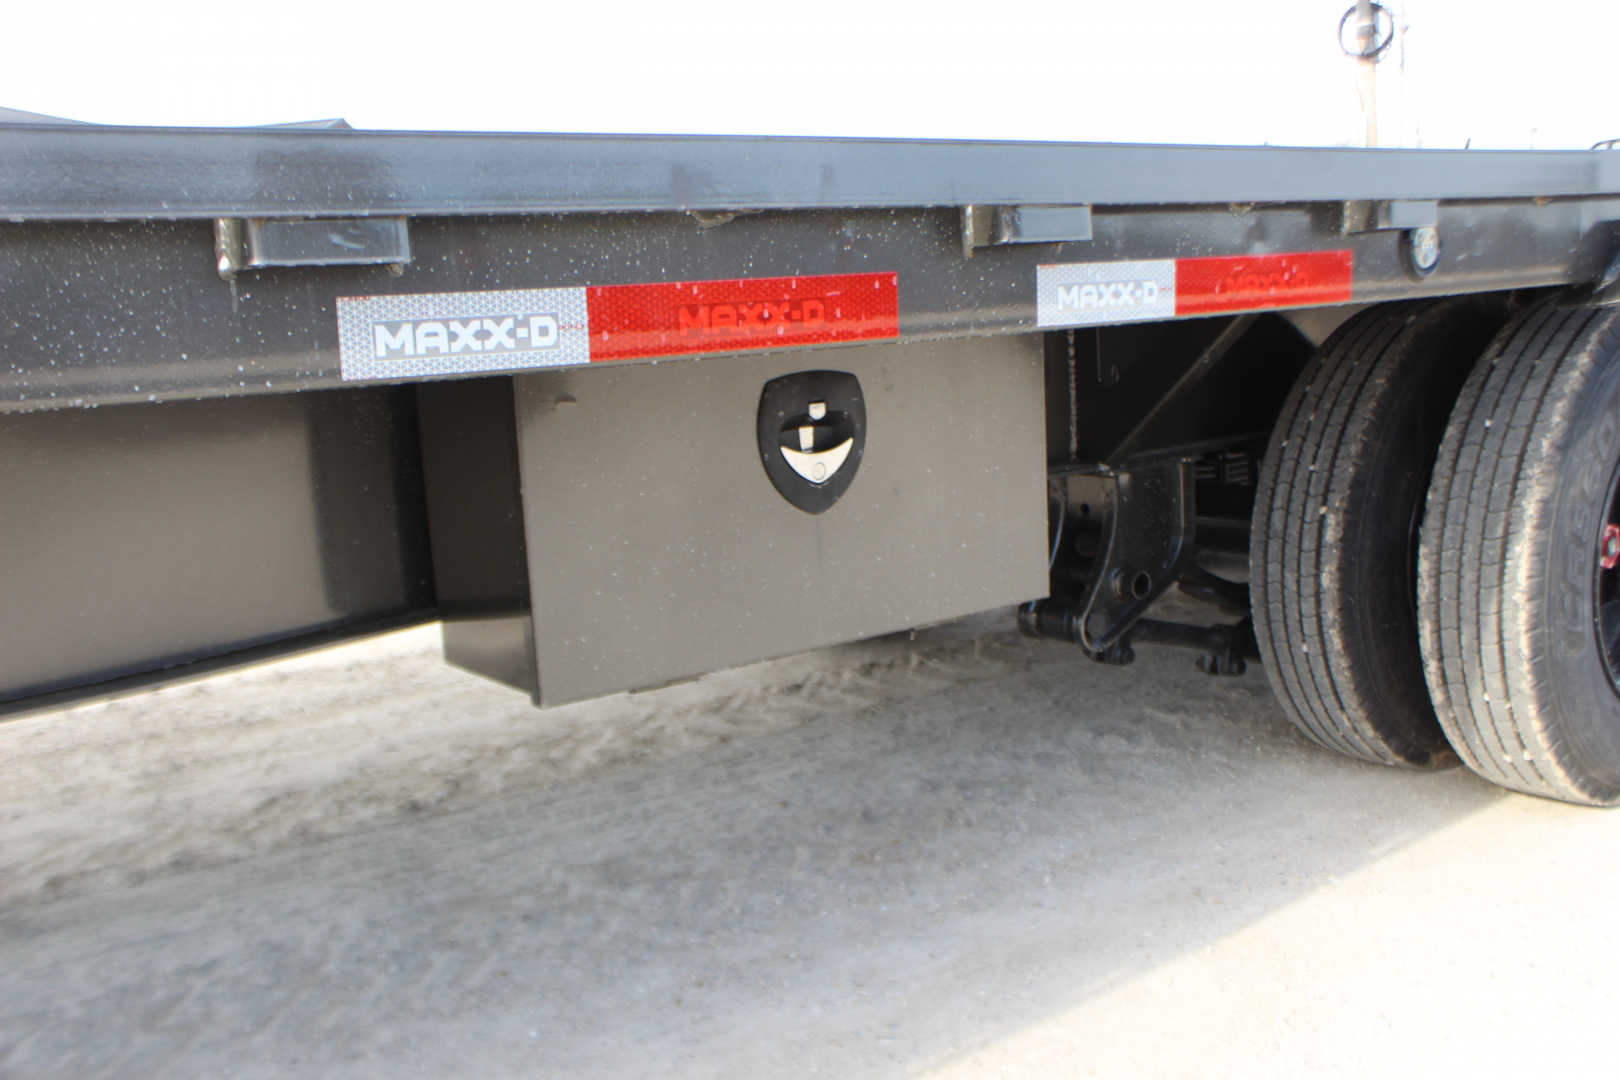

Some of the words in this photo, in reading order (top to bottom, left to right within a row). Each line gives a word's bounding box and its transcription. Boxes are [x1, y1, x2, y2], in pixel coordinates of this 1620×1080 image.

[1057, 281, 1159, 311] MAXX-D
[374, 312, 558, 358] MAXX-D
[679, 300, 825, 336] MAXX-D
